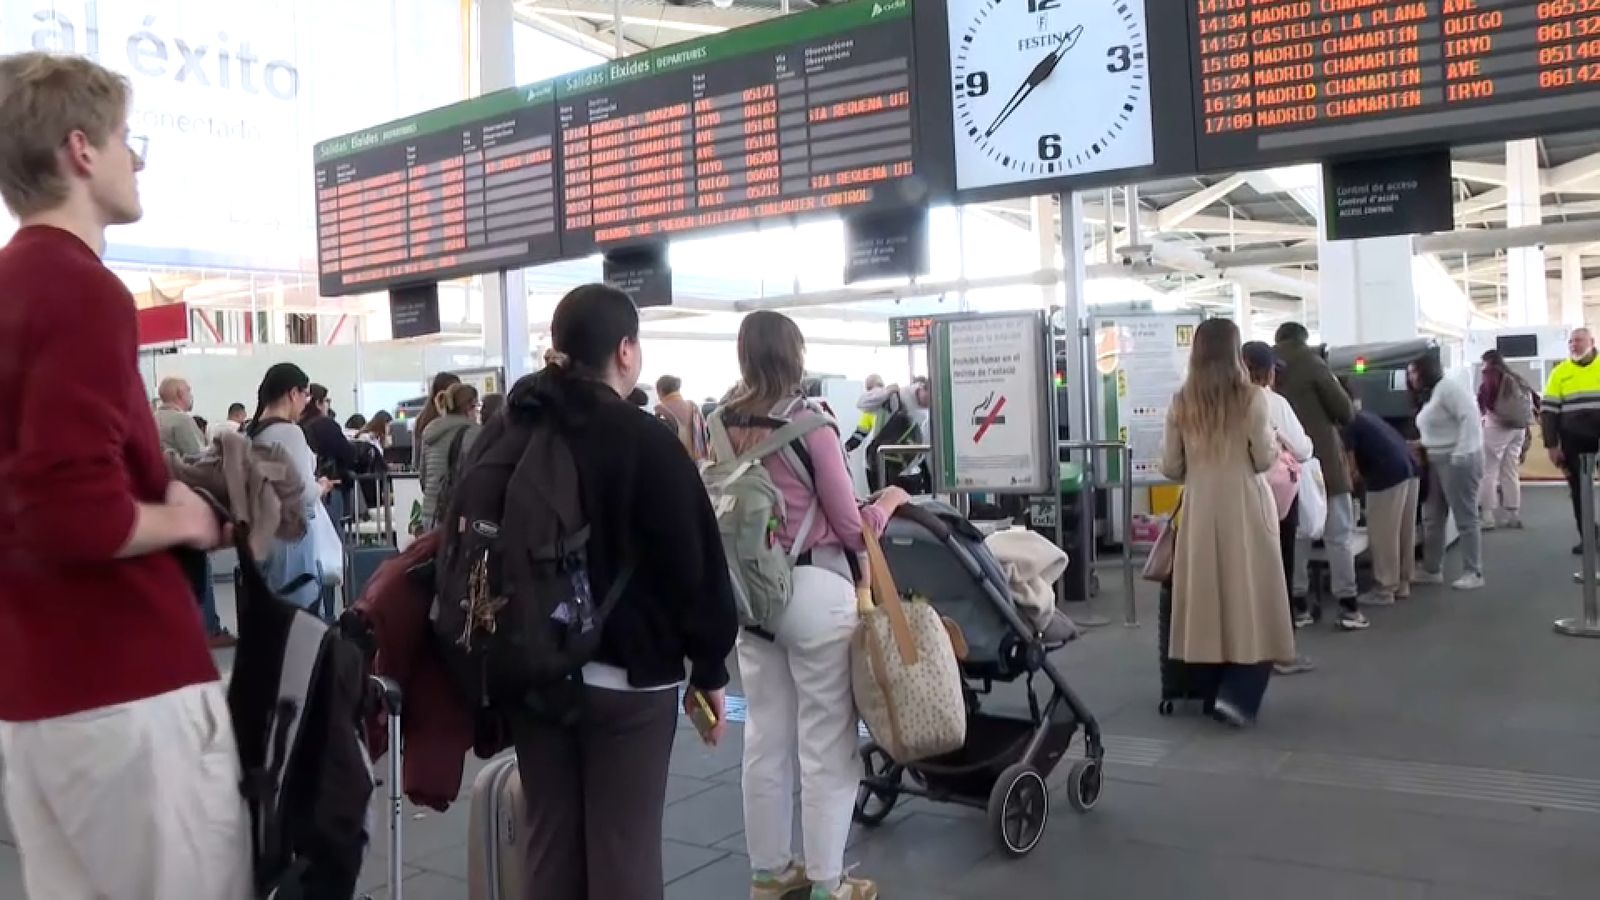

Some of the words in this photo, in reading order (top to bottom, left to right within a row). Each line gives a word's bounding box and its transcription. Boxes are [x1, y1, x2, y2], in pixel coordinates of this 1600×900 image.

[1200, 12, 1247, 34] 14:34
[1251, 2, 1311, 25] MADRID
[1201, 32, 1248, 55] 14:57
[1341, 13, 1363, 31] LA
[1372, 3, 1427, 27] PLANA
[1443, 0, 1478, 14] AVE
[31, 0, 99, 53] al
[126, 15, 299, 101] éxito
[1018, 32, 1072, 52] FESTINA
[1202, 53, 1250, 75] 15:09
[1254, 44, 1314, 67] MADRID
[1444, 12, 1502, 36] OUIGO
[1202, 73, 1250, 95] 15:24
[1254, 64, 1315, 88] MADRID
[1444, 36, 1491, 58] IRYO
[1537, 17, 1600, 43] 06132
[566, 71, 605, 92] Salidas
[610, 58, 650, 82] Eixides
[1106, 45, 1131, 74] 3
[966, 71, 989, 98] 9
[1204, 92, 1252, 115] 16:34
[1255, 84, 1317, 108] MADRID
[1446, 60, 1482, 81] AVE
[1538, 41, 1600, 67] 05140
[1204, 112, 1253, 136] 17:09
[1256, 104, 1317, 128] MADRID
[1446, 80, 1494, 103] IRYO
[1538, 63, 1600, 89] 06142
[1038, 133, 1063, 161] 6
[1337, 185, 1370, 196] Control
[1371, 183, 1384, 193] de
[1386, 180, 1419, 192] acceso
[1338, 196, 1368, 206] Control
